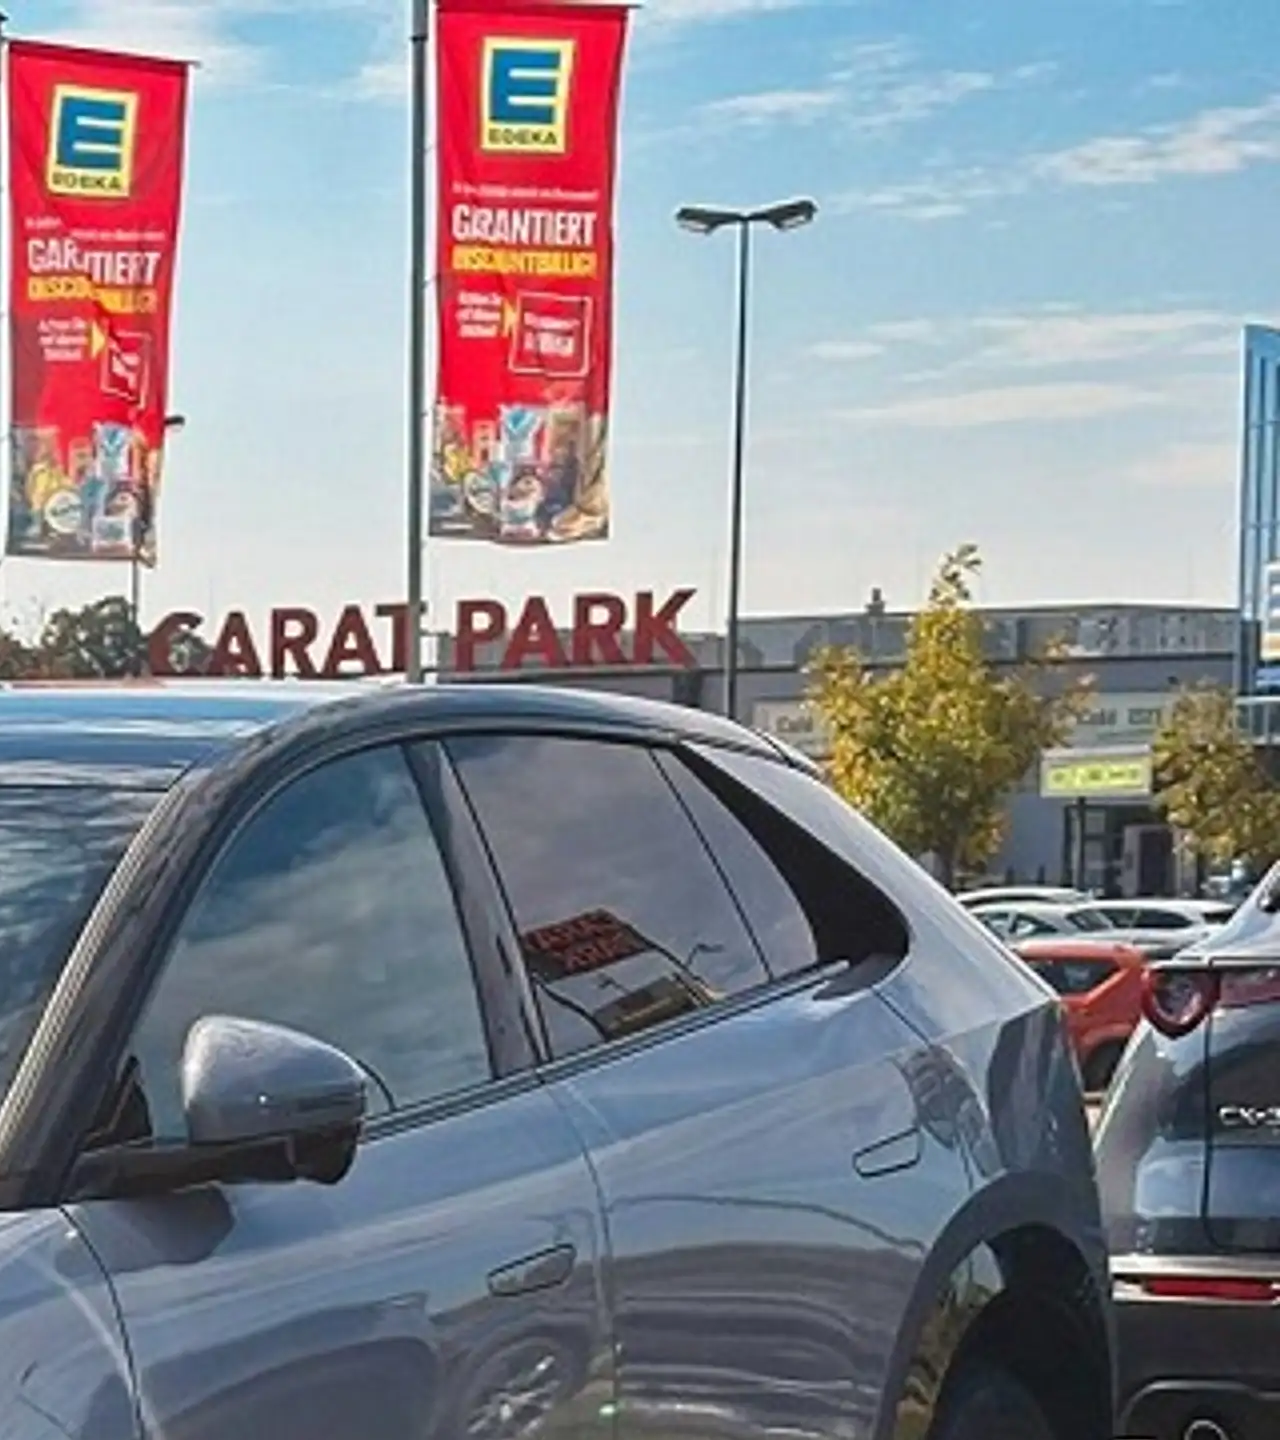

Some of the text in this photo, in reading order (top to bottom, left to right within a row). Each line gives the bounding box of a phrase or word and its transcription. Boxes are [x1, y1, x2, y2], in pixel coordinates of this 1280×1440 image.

[488, 128, 558, 145] EDEKA
[51, 172, 123, 191] EDEKA
[149, 588, 698, 679] CARAT PARK
